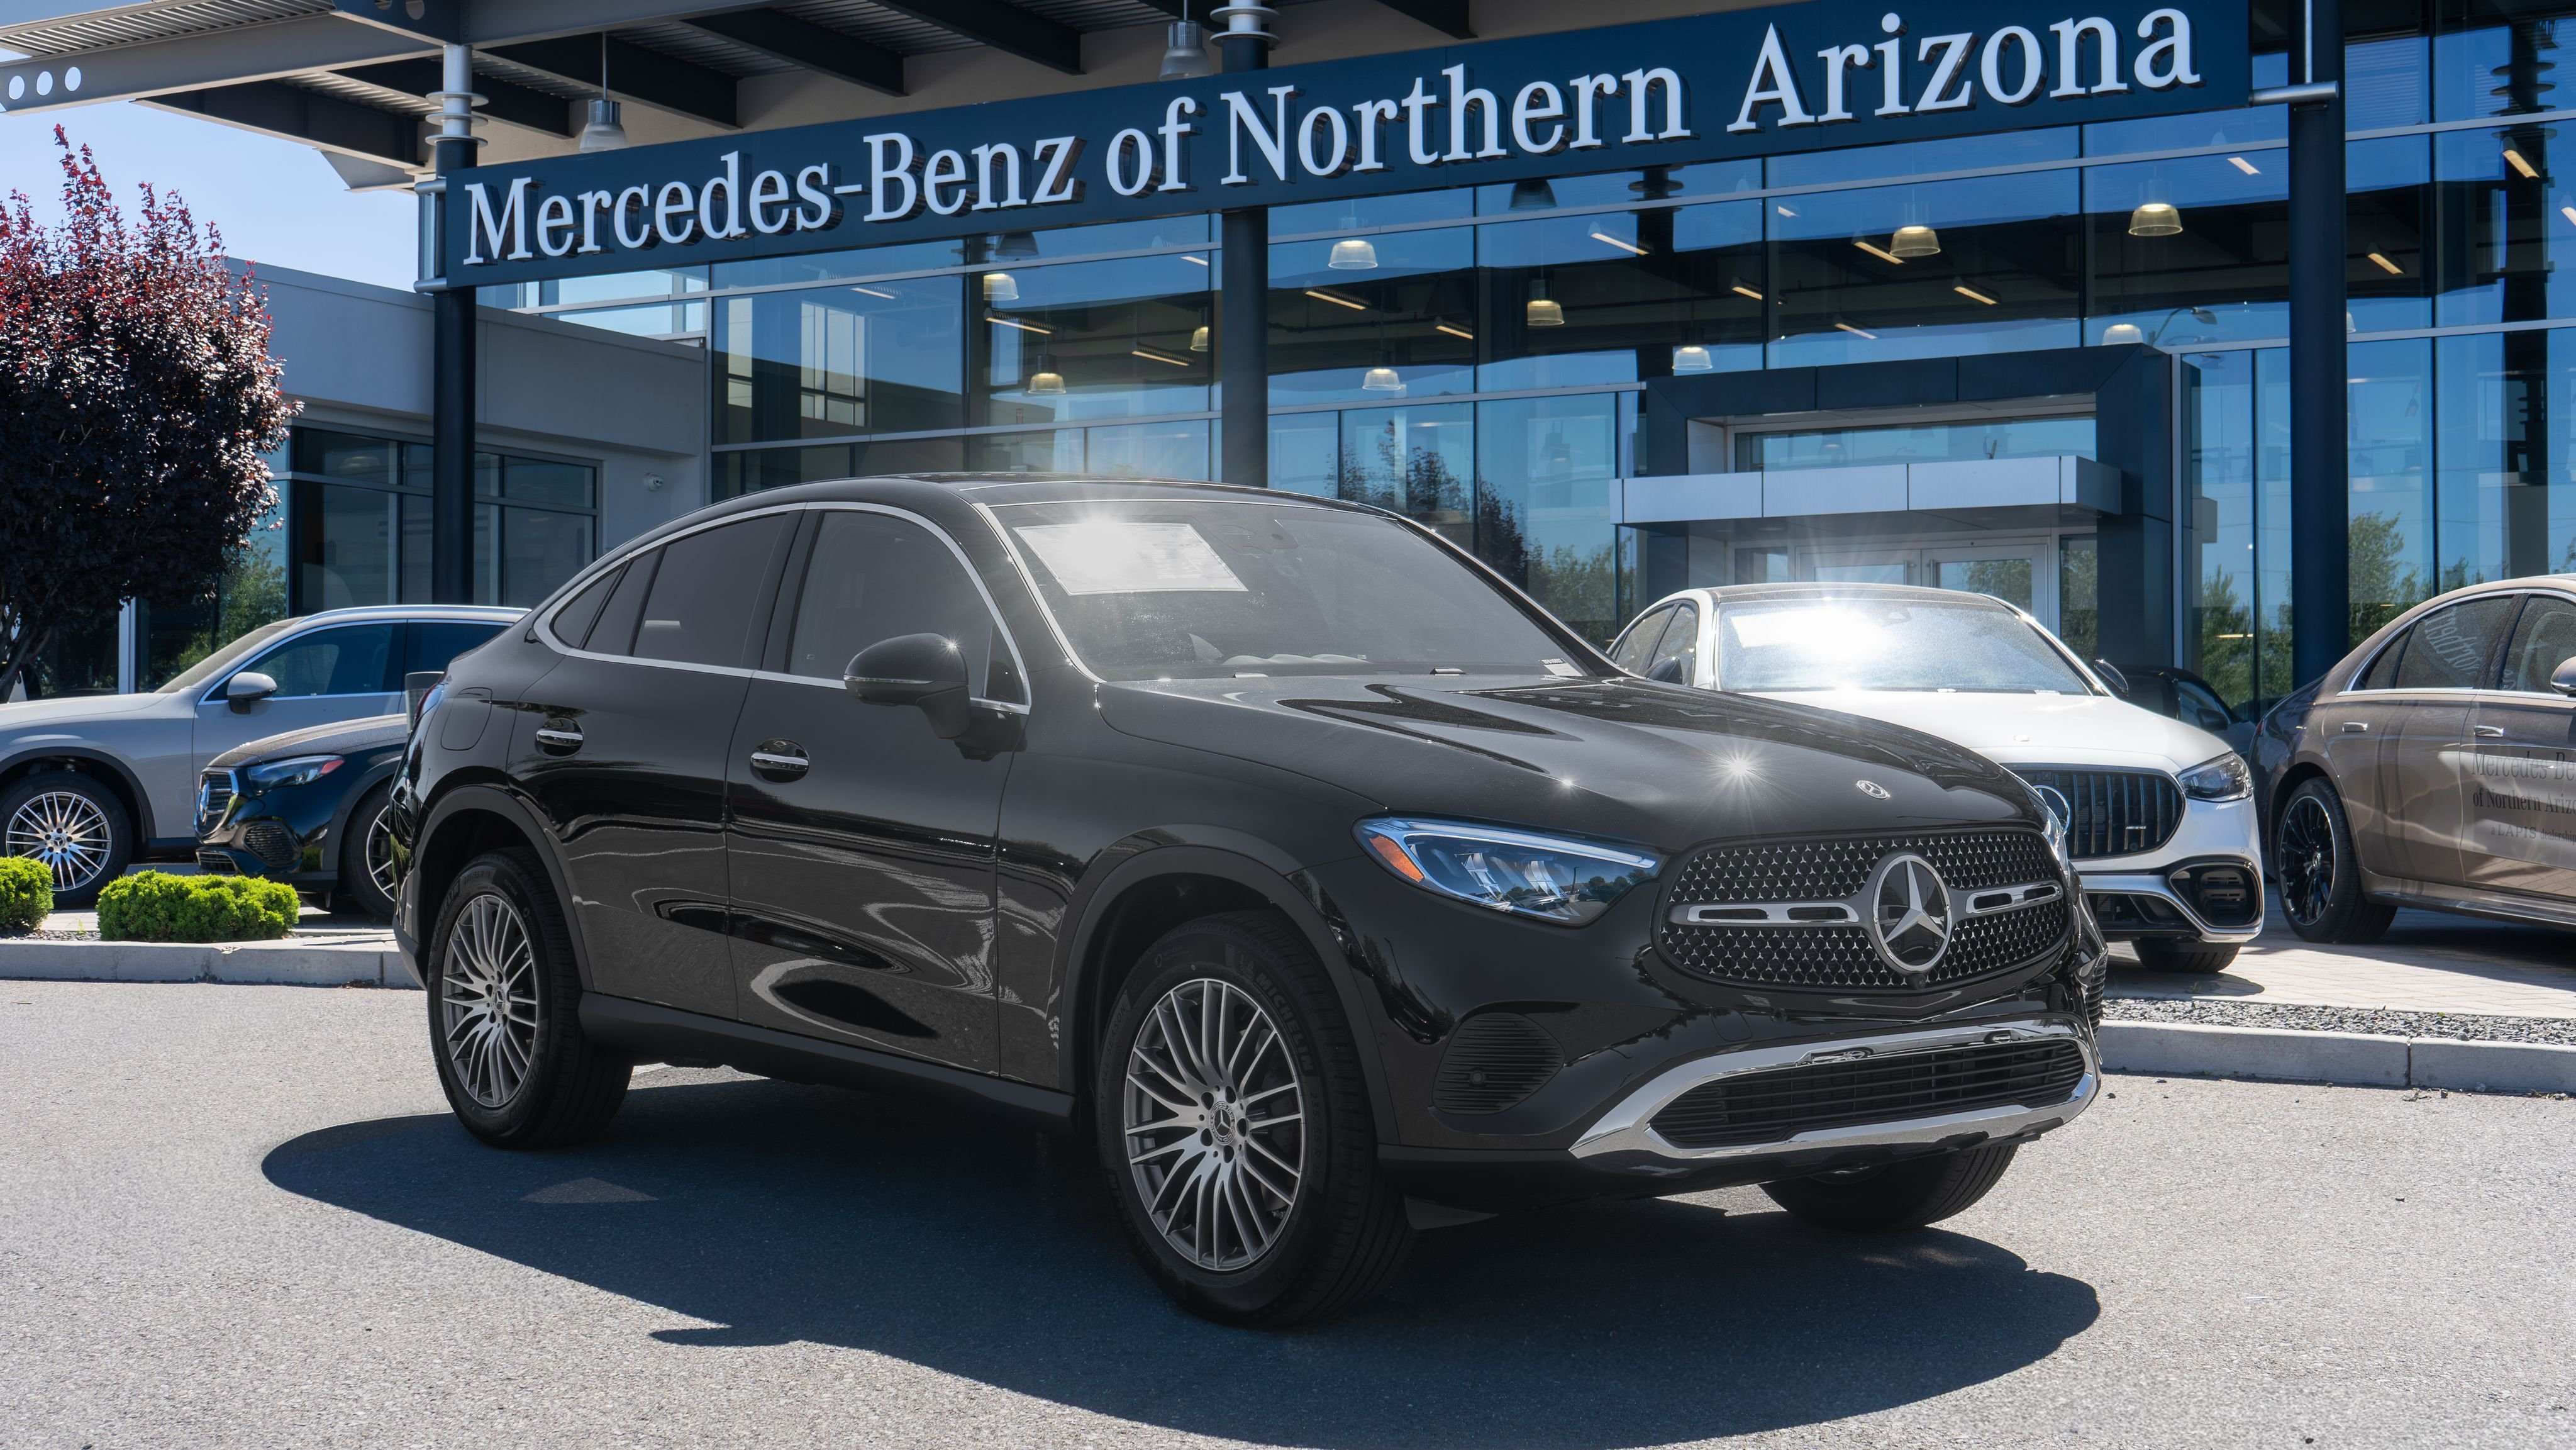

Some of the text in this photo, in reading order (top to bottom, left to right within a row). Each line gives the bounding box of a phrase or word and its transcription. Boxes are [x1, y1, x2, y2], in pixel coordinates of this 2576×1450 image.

[464, 8, 2200, 264] Mercedes-Benz of Northern Arizona
[2473, 787, 2483, 807] of
[2487, 788, 2540, 811] Northern
[2491, 826, 2495, 835] a
[2498, 824, 2536, 839] LAPIS
[1106, 1004, 1126, 1056] SEASON
[1255, 971, 1314, 1071] MICHELIN
[1310, 1092, 1321, 1143] 235/55
[1314, 1148, 1321, 1158] R
